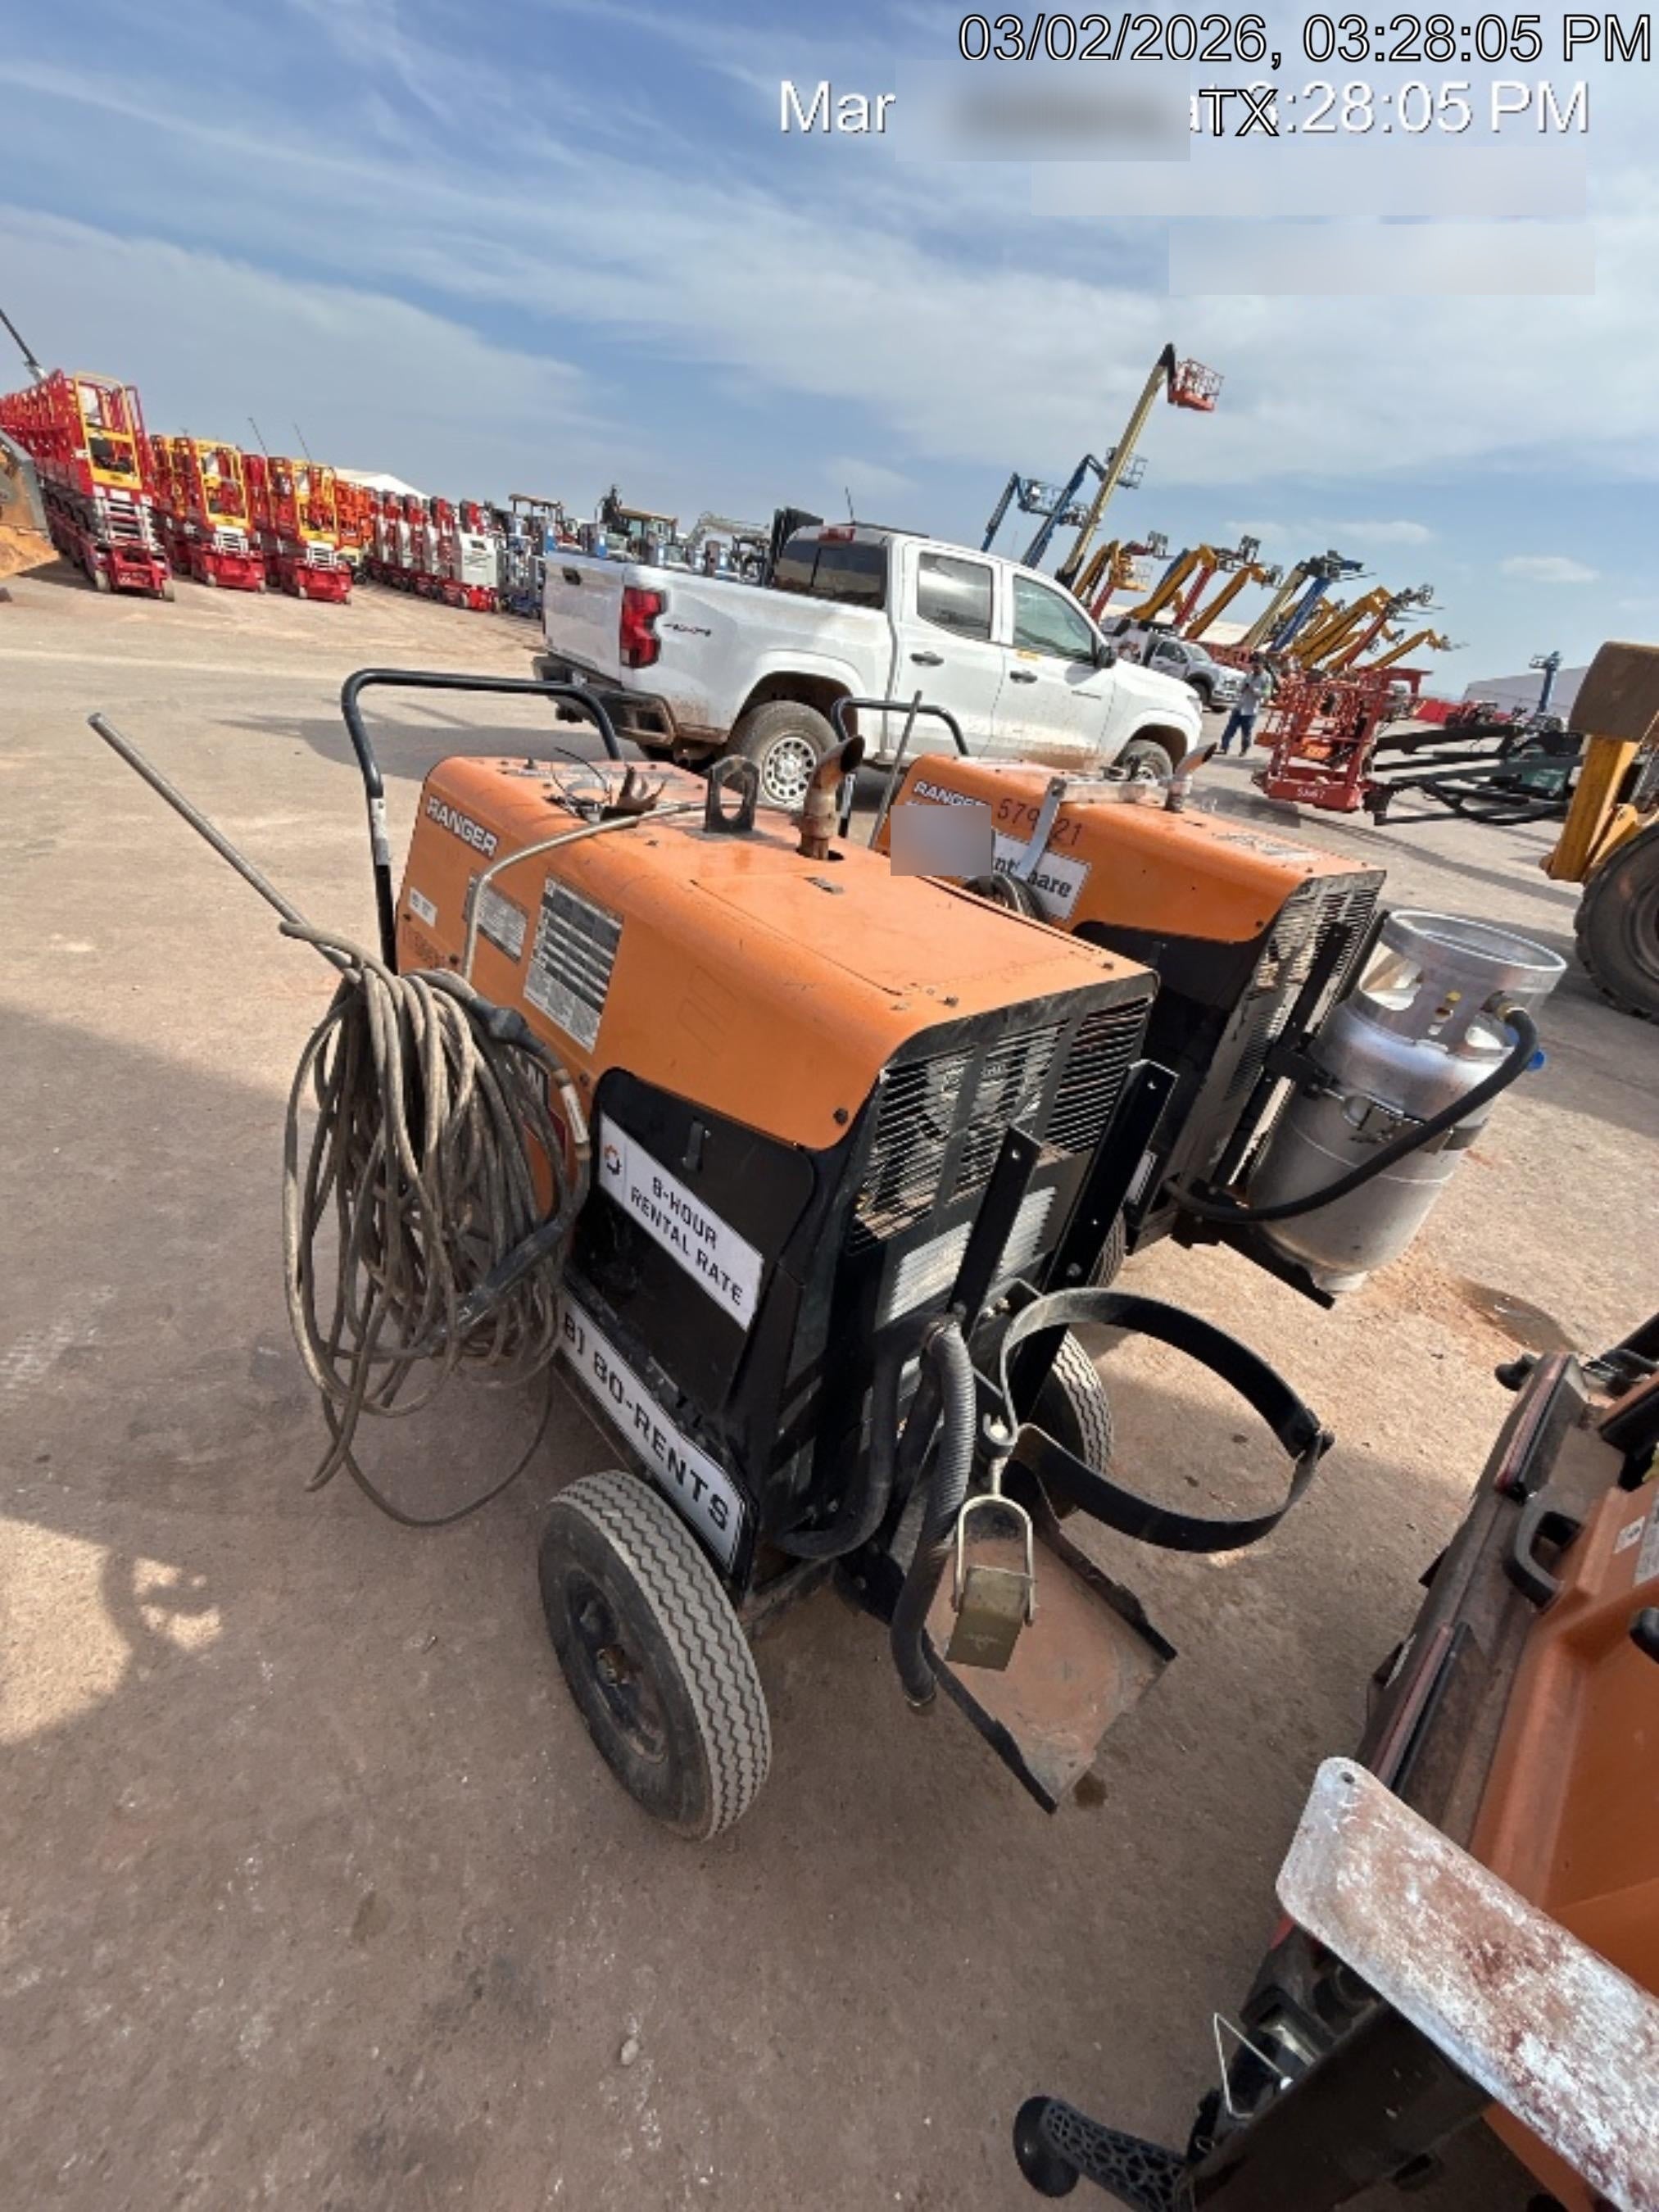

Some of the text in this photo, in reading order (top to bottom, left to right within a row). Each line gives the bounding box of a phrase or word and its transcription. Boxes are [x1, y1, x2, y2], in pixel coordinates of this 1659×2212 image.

[426, 796, 499, 859] RANGER
[997, 798, 1082, 846] 57921
[630, 1185, 743, 1307] RENTAL RATE
